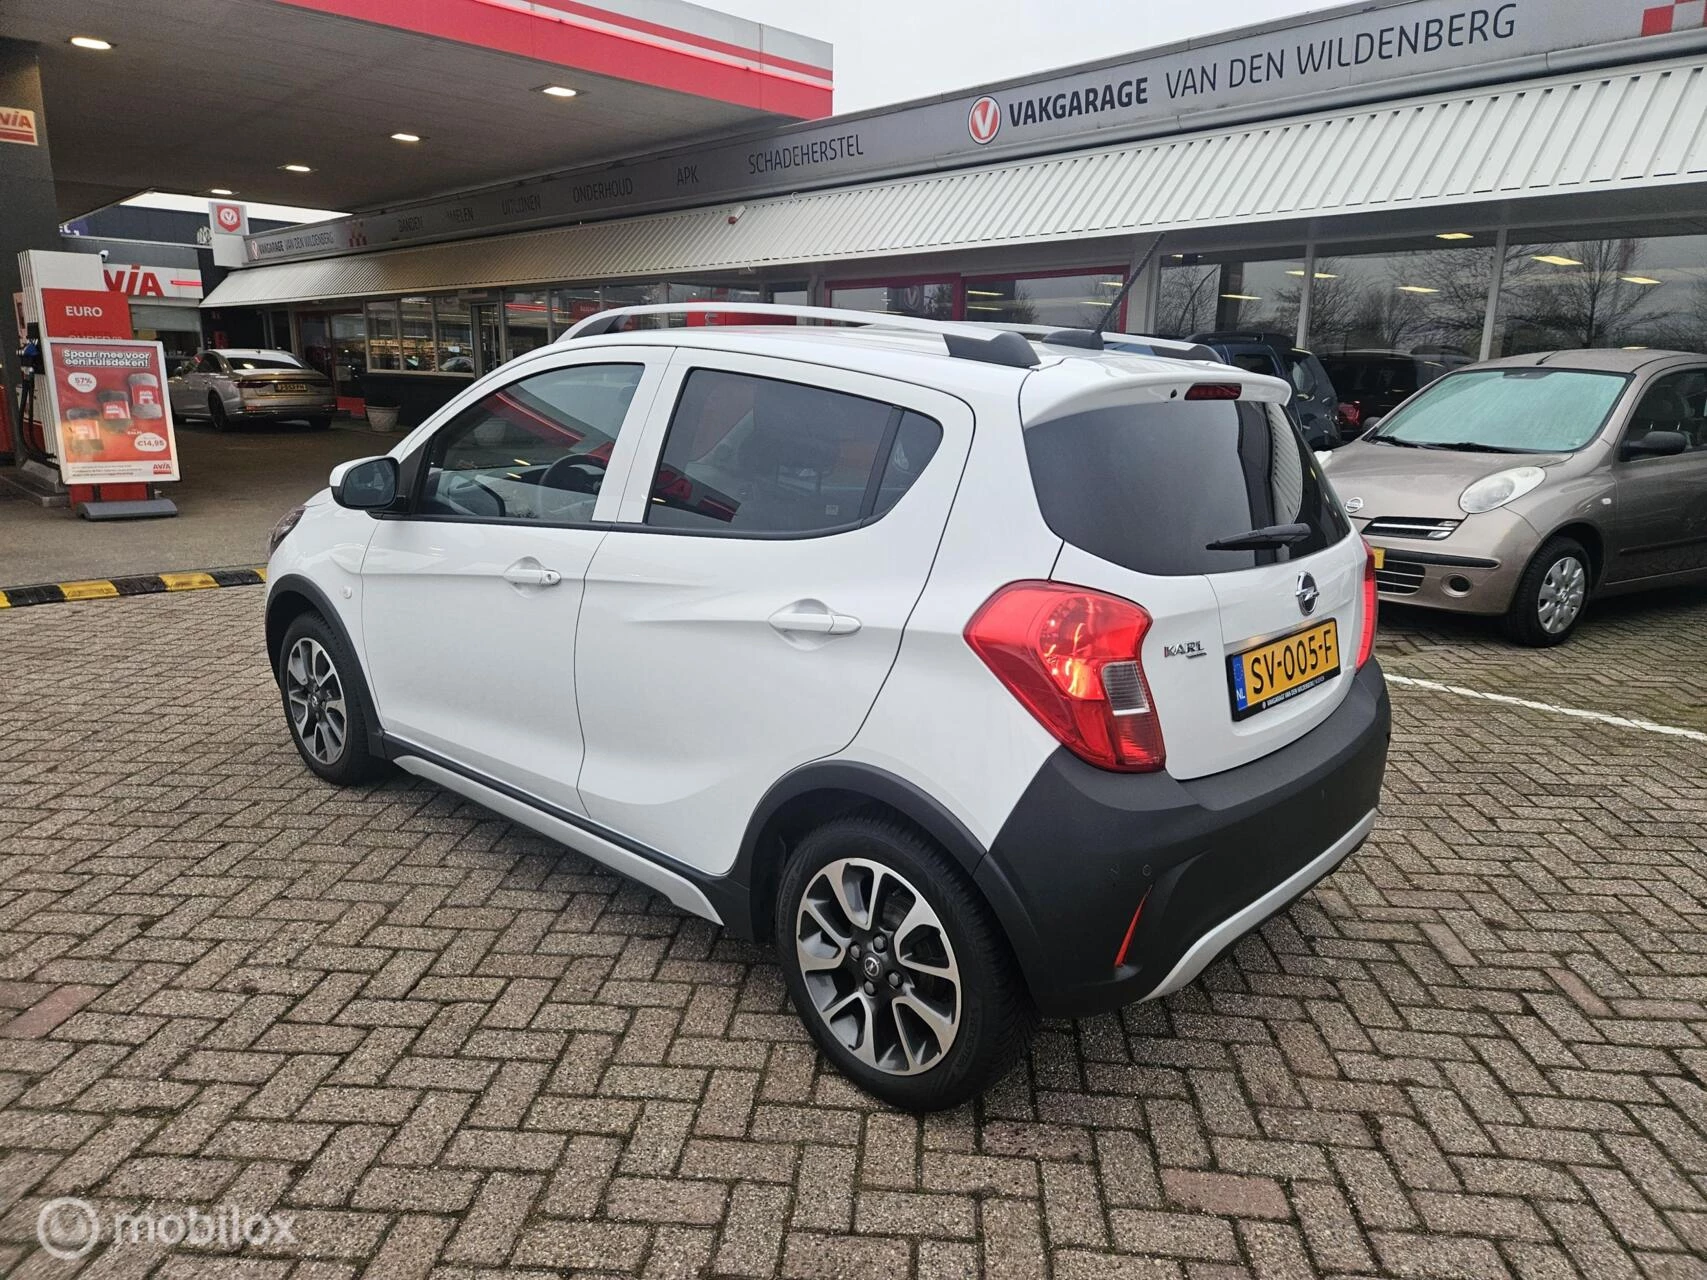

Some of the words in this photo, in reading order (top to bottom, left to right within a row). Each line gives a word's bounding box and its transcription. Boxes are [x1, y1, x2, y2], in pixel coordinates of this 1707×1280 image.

[1009, 78, 1148, 127] VAKGARAGE
[1166, 63, 1217, 99] VAN
[1229, 49, 1285, 89] DEN
[1296, 3, 1517, 75] WILDENBERG
[572, 177, 633, 203] ONDERHOUD
[677, 165, 698, 187] APK
[748, 134, 864, 175] SCHADEHERSTEL
[65, 306, 103, 317] EURO
[64, 350, 98, 359] Spaar
[1163, 641, 1204, 657] KARL
[1251, 629, 1332, 695] SV-005-F
[1236, 688, 1246, 700] NL
